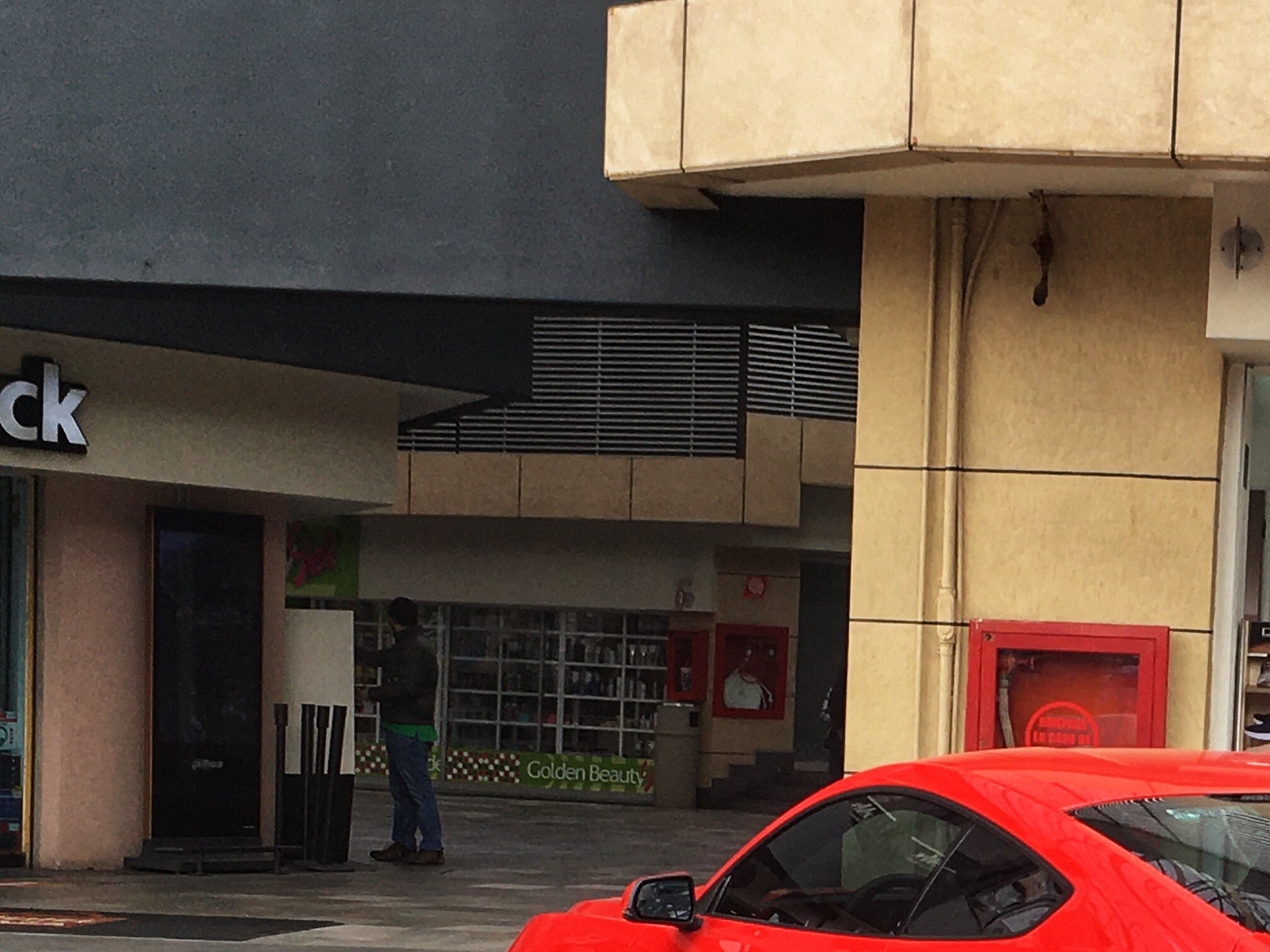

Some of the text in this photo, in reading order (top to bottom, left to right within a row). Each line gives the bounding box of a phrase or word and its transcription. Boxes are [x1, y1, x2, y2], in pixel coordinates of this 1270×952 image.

[0, 362, 88, 446] ck
[527, 760, 646, 787] Golden Beauty
